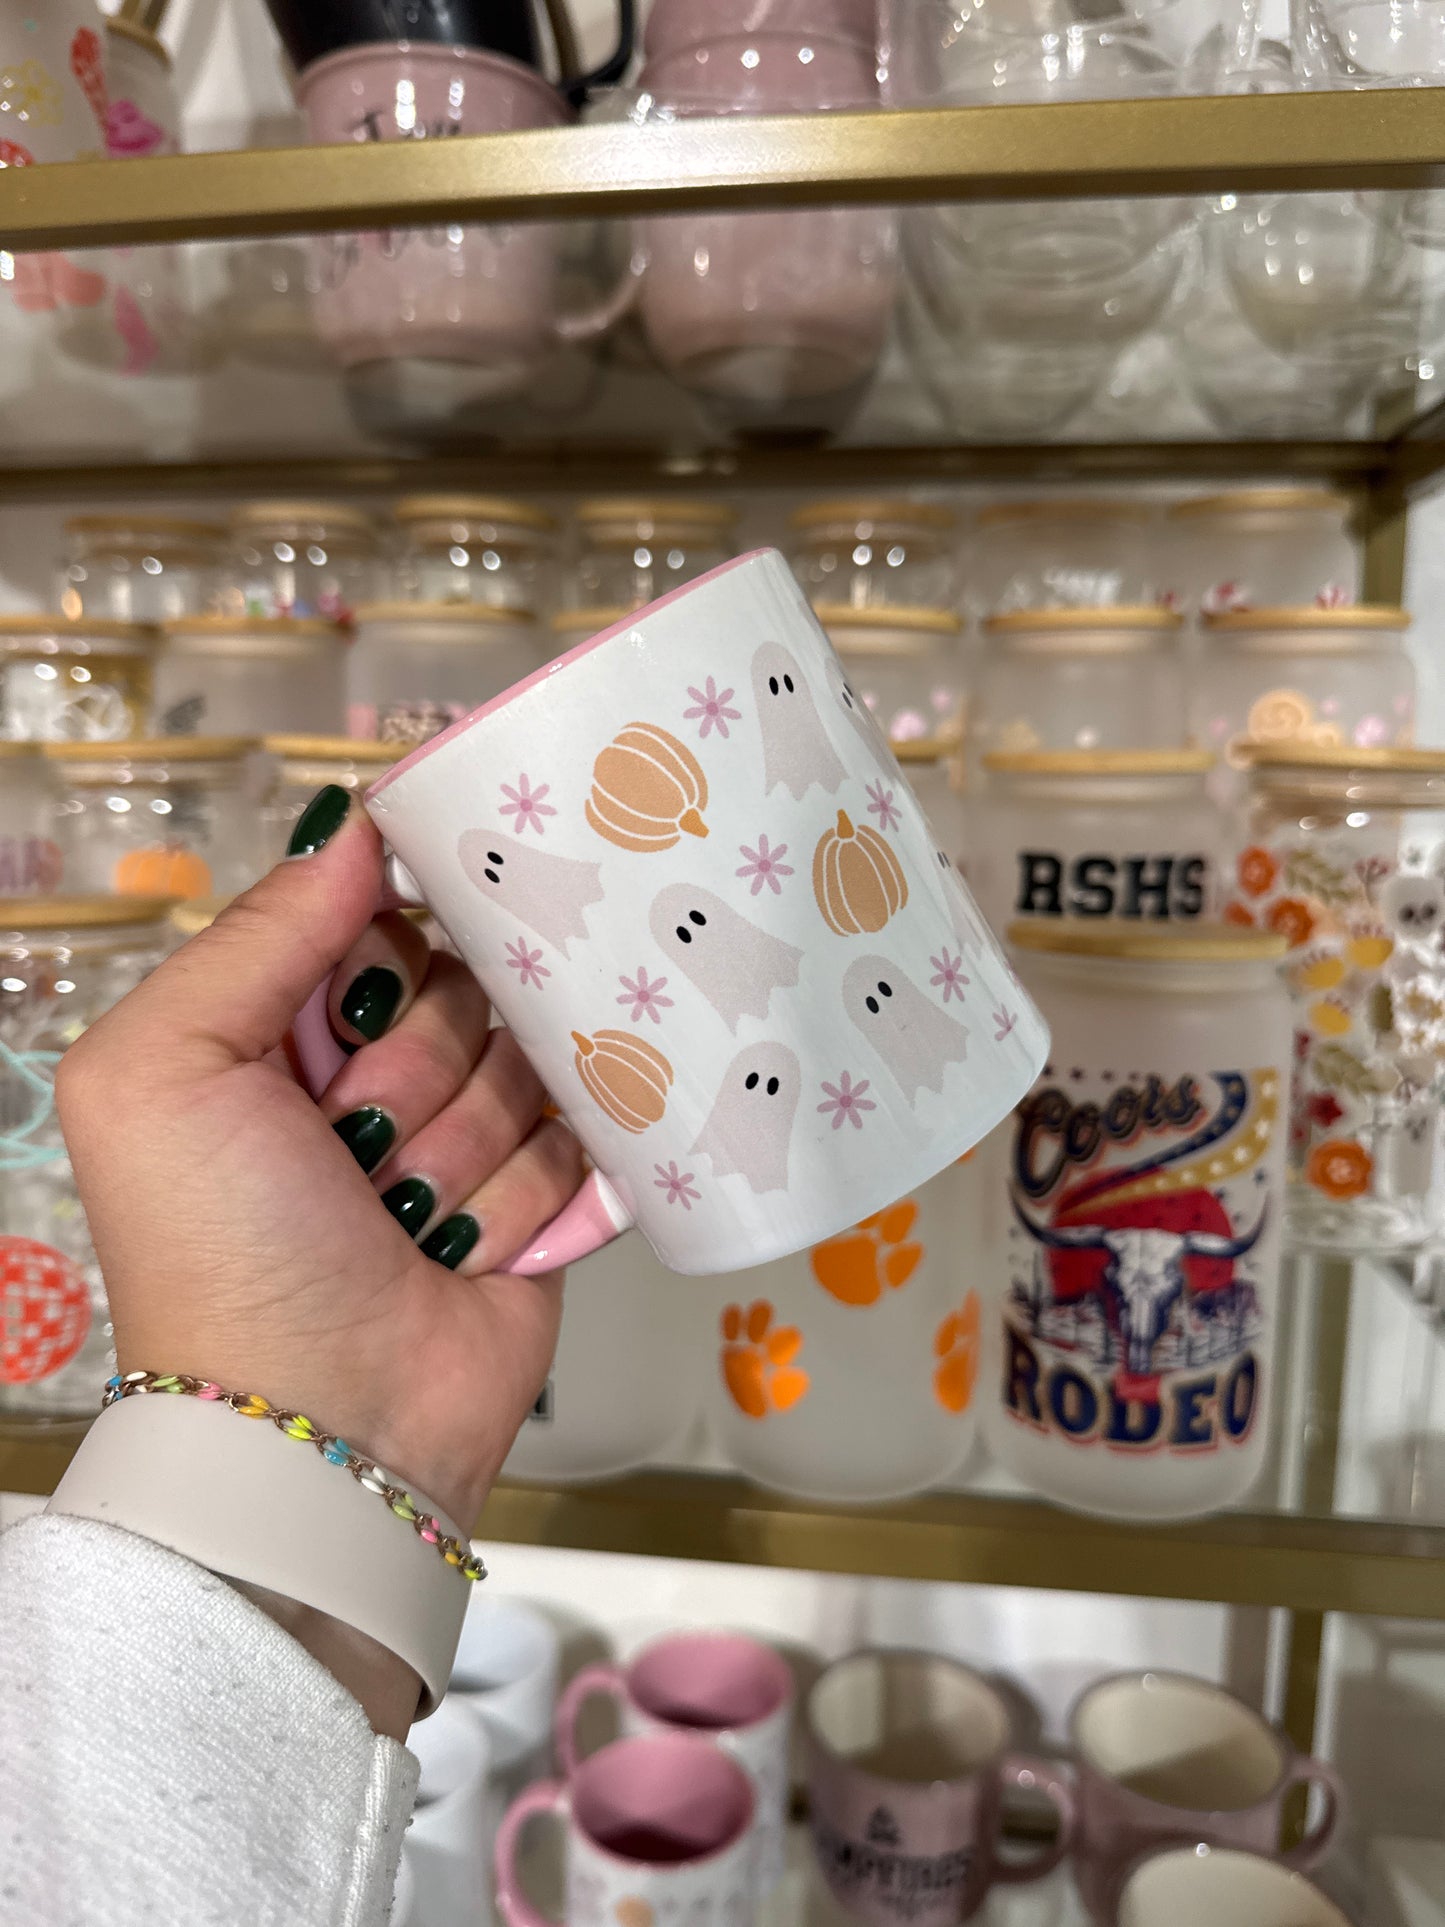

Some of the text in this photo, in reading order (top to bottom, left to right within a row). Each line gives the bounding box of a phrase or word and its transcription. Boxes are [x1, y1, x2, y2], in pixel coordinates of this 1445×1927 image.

[1017, 851, 1207, 918] RSHS
[1011, 1074, 1205, 1203] Coors
[1002, 1321, 1257, 1453] RODEO
